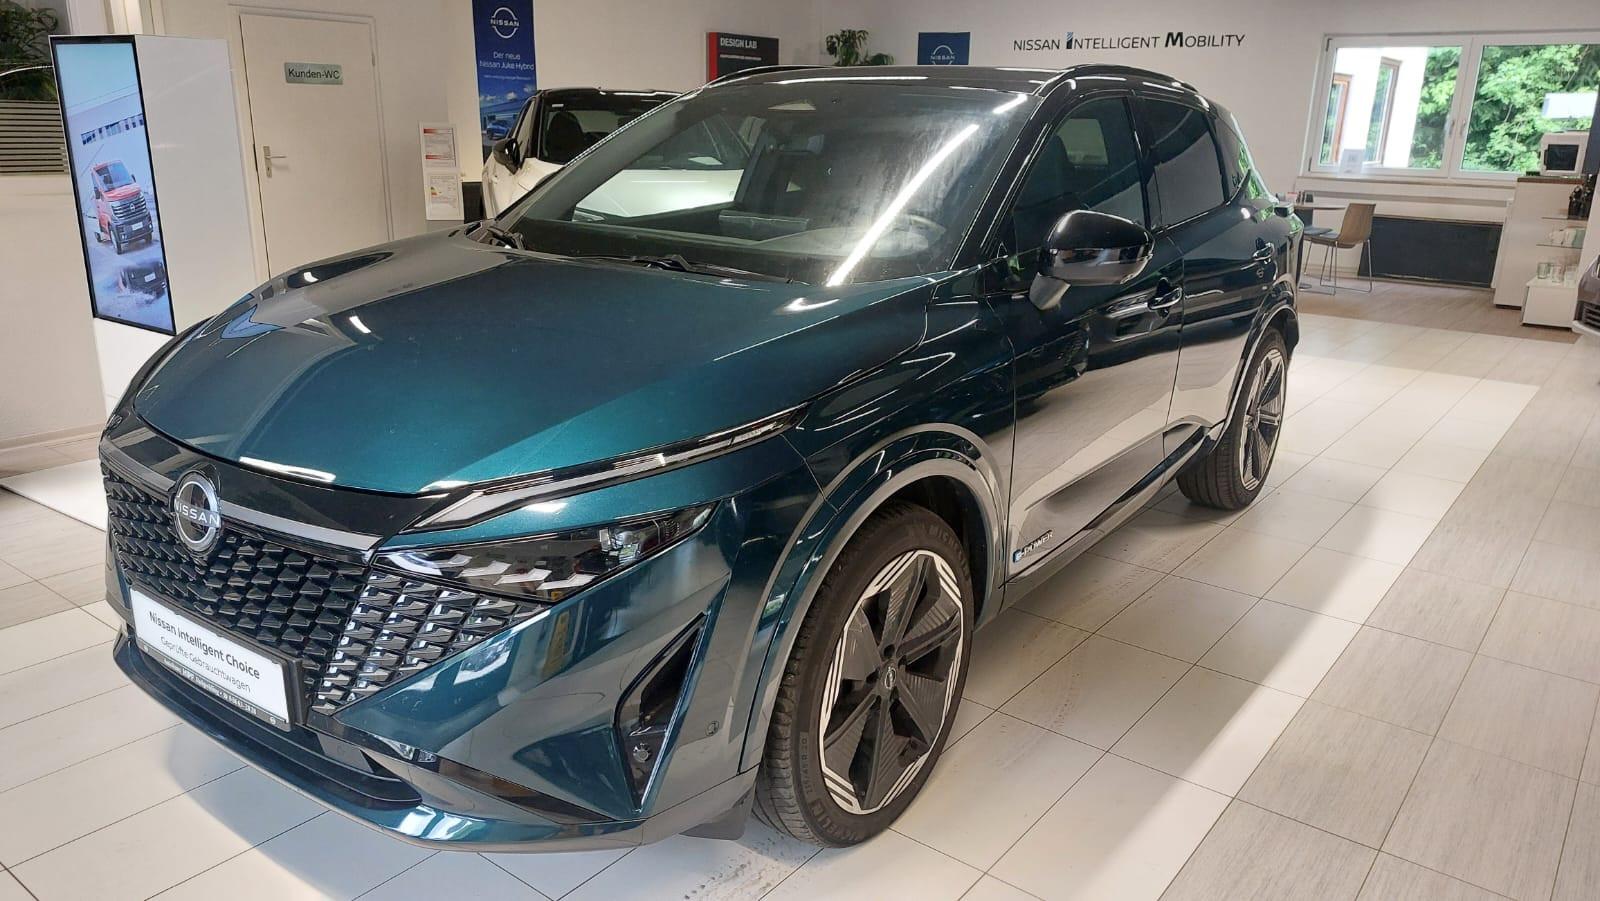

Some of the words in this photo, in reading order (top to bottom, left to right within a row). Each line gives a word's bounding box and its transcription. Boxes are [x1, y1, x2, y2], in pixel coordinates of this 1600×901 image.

[491, 19, 520, 27] NISSAN
[720, 37, 745, 48] DESIGN
[745, 39, 758, 49] LAB
[1013, 39, 1061, 51] NISSAN
[1066, 32, 1161, 49] INTELLIGENT
[1165, 31, 1245, 48] MOBILITY
[493, 51, 504, 59] Der
[501, 61, 515, 69] Juke
[515, 62, 535, 71] Hybrid
[288, 68, 341, 79] Kunden-WC
[174, 498, 219, 525] NISSAN
[149, 610, 177, 636] Nissan
[178, 628, 226, 662] Intelligent
[226, 653, 261, 680] Choice
[188, 652, 251, 693] Gebrauchtwagen
